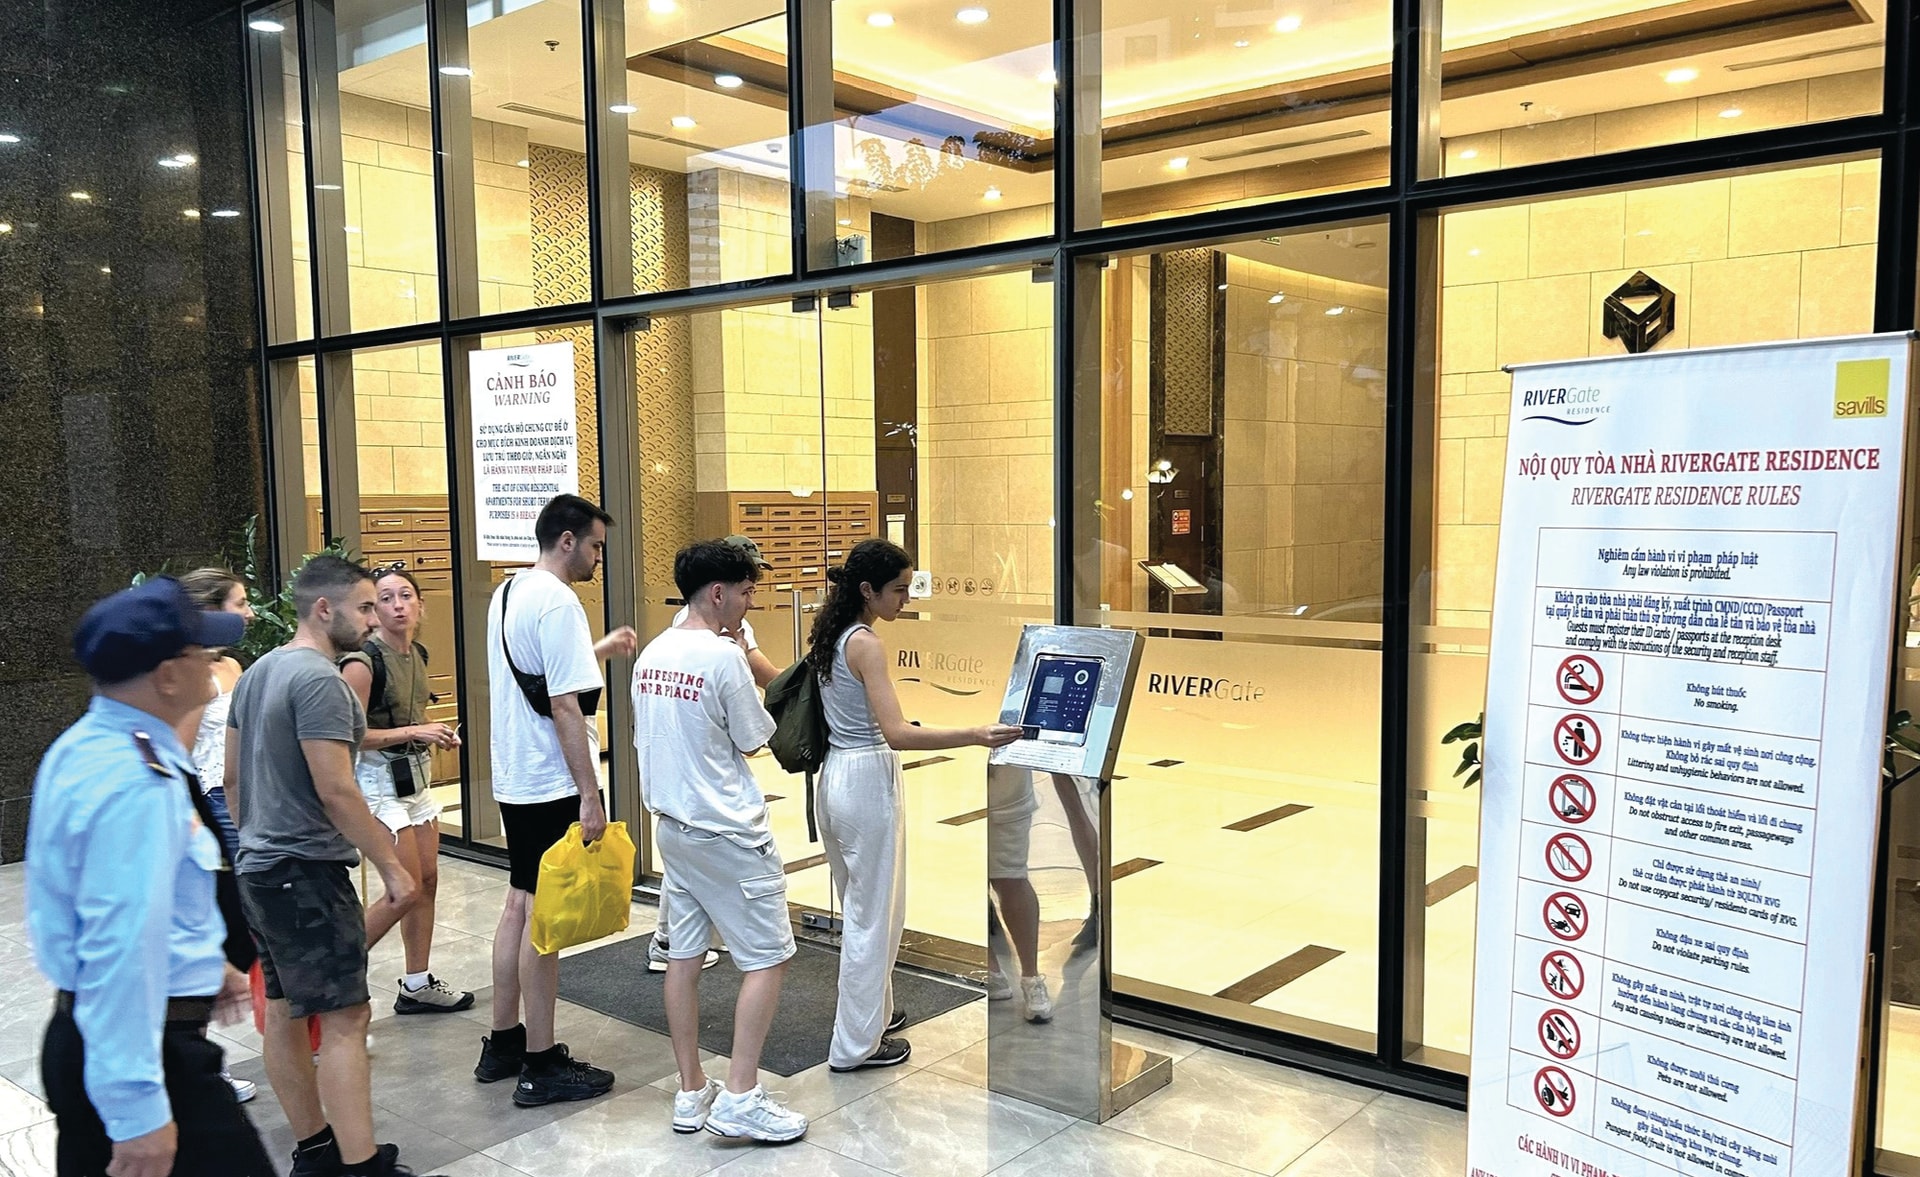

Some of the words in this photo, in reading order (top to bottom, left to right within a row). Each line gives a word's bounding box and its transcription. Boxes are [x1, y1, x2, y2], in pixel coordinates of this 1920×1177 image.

[486, 371, 524, 391] CẢNH
[529, 369, 557, 388] BÁO
[494, 391, 551, 406] WARNING
[1523, 386, 1600, 406] RIVERGate
[1835, 396, 1885, 416] savills
[1566, 406, 1611, 415] RESIDENCE
[1519, 453, 1546, 481] NỘI
[1550, 456, 1581, 481] QUY
[1585, 451, 1616, 474] TÒA
[1620, 449, 1656, 474] NHÀ
[1660, 451, 1760, 473] RIVERGATE
[1765, 448, 1880, 471] RESIDENCE
[1571, 486, 1651, 506] RIVERGATE
[1654, 486, 1743, 506] RESIDENCE
[1746, 485, 1802, 506] RULES
[1622, 564, 1636, 579] Any
[1637, 564, 1649, 576] law
[1650, 564, 1680, 578] violation
[1681, 566, 1688, 578] is
[1689, 567, 1731, 581] prohibited.
[1148, 673, 1265, 702] RIVERGate
[1693, 698, 1704, 708] No
[1706, 700, 1739, 713] smoking.
[1627, 757, 1655, 772] Littering
[1655, 761, 1669, 772] and
[1670, 764, 1709, 780] unhygienic
[1710, 769, 1745, 784] behaviors
[1746, 776, 1758, 786] are
[1759, 778, 1772, 788] not
[1773, 780, 1805, 793] allowed.
[1628, 806, 1637, 816] Do
[1638, 808, 1650, 818] not
[1651, 810, 1680, 824] obstruct
[1681, 817, 1704, 828] access
[1705, 820, 1713, 829] to
[1713, 821, 1727, 832] fire
[1728, 824, 1745, 836] exit,
[1745, 828, 1794, 846] passageways
[1664, 827, 1678, 836] and
[1679, 829, 1698, 840] other
[1699, 833, 1730, 846] common
[1731, 838, 1753, 850] areas.
[1618, 877, 1627, 887] Do
[1628, 880, 1640, 891] not
[1641, 883, 1652, 893] use
[1652, 886, 1680, 900] copycat
[1680, 892, 1714, 908] security/
[1714, 899, 1747, 914] residents
[1749, 906, 1769, 920] cards
[1769, 910, 1779, 924] of
[1779, 914, 1797, 927] RVG.
[1652, 941, 1662, 951] Do
[1663, 944, 1675, 954] not
[1676, 947, 1700, 961] violate
[1701, 953, 1729, 970] parking
[1730, 962, 1750, 973] rules.
[1657, 1072, 1672, 1084] Pets
[1673, 1078, 1684, 1088] are
[1685, 1082, 1698, 1093] not
[1699, 1086, 1728, 1103] allowed.
[1518, 1134, 1534, 1154] CÁC
[1535, 1141, 1559, 1165] HÀNH
[1560, 1151, 1569, 1170] VI
[1570, 1157, 1580, 1175] VI
